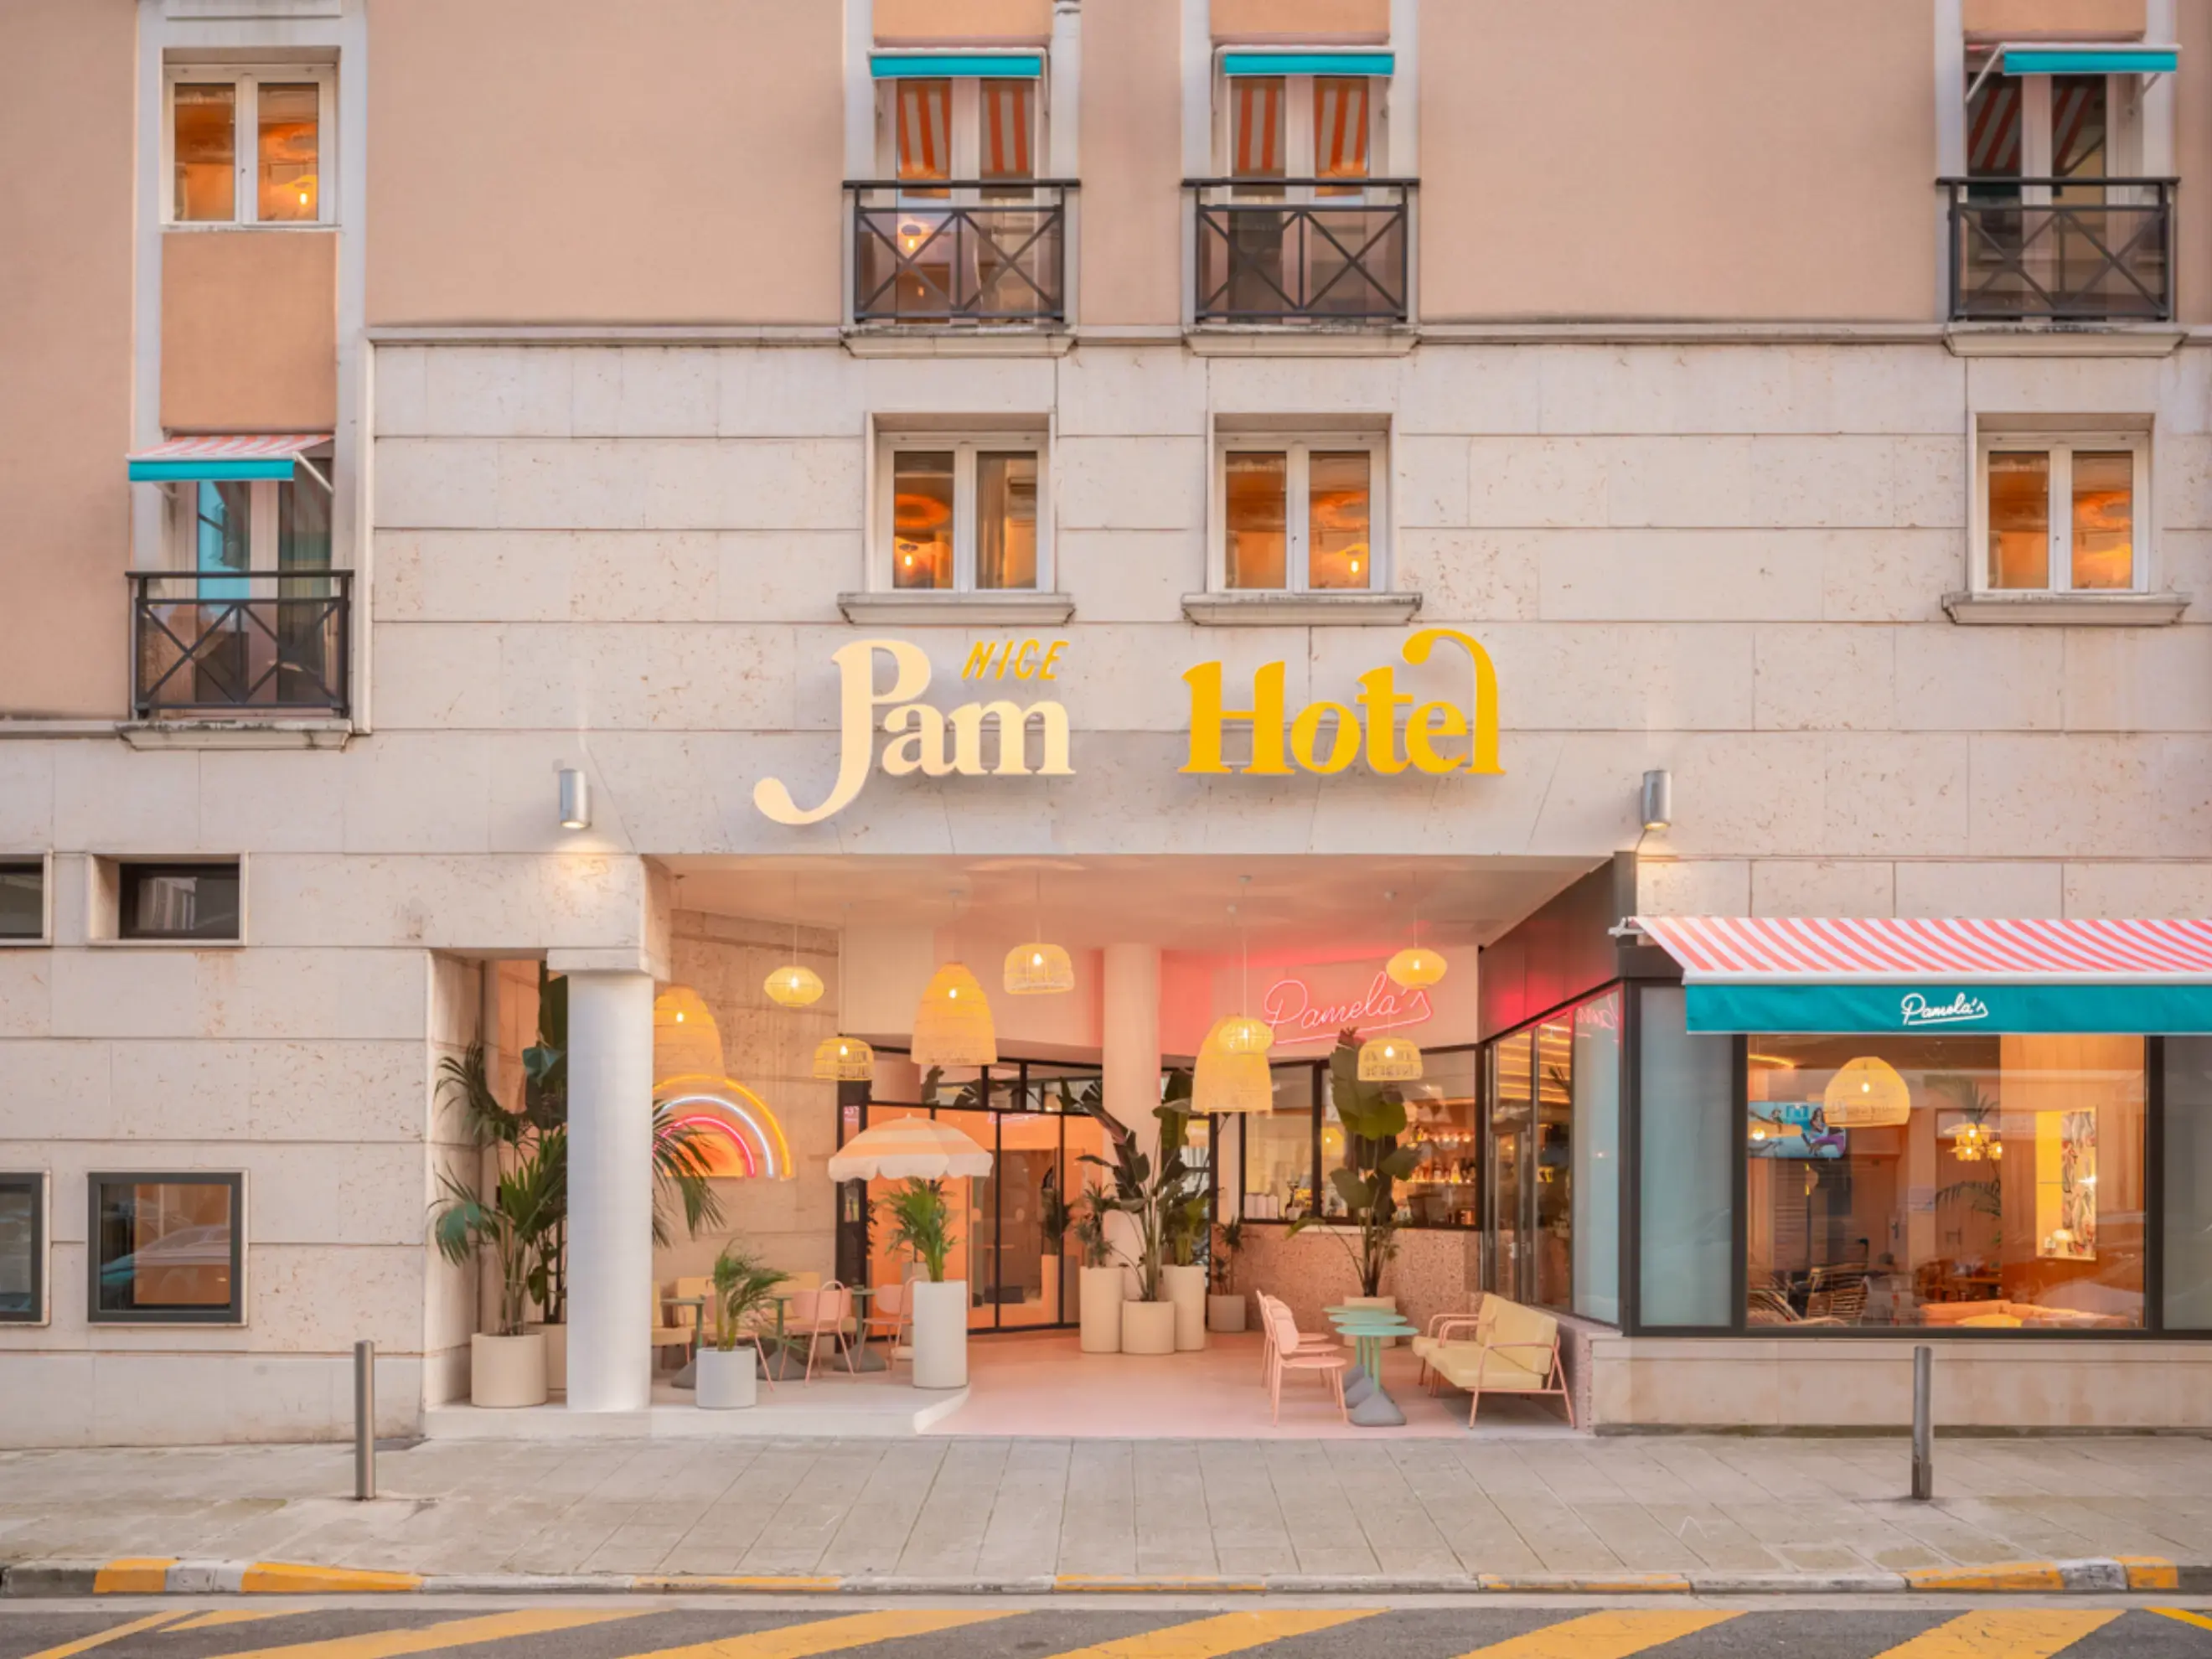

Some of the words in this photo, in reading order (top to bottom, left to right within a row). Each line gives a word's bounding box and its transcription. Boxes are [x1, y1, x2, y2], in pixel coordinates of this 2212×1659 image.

[961, 638, 1070, 680] NICE
[1177, 628, 1507, 776] Hotel
[1264, 970, 1432, 1045] Pamela's
[1900, 991, 1989, 1026] Pamela's
